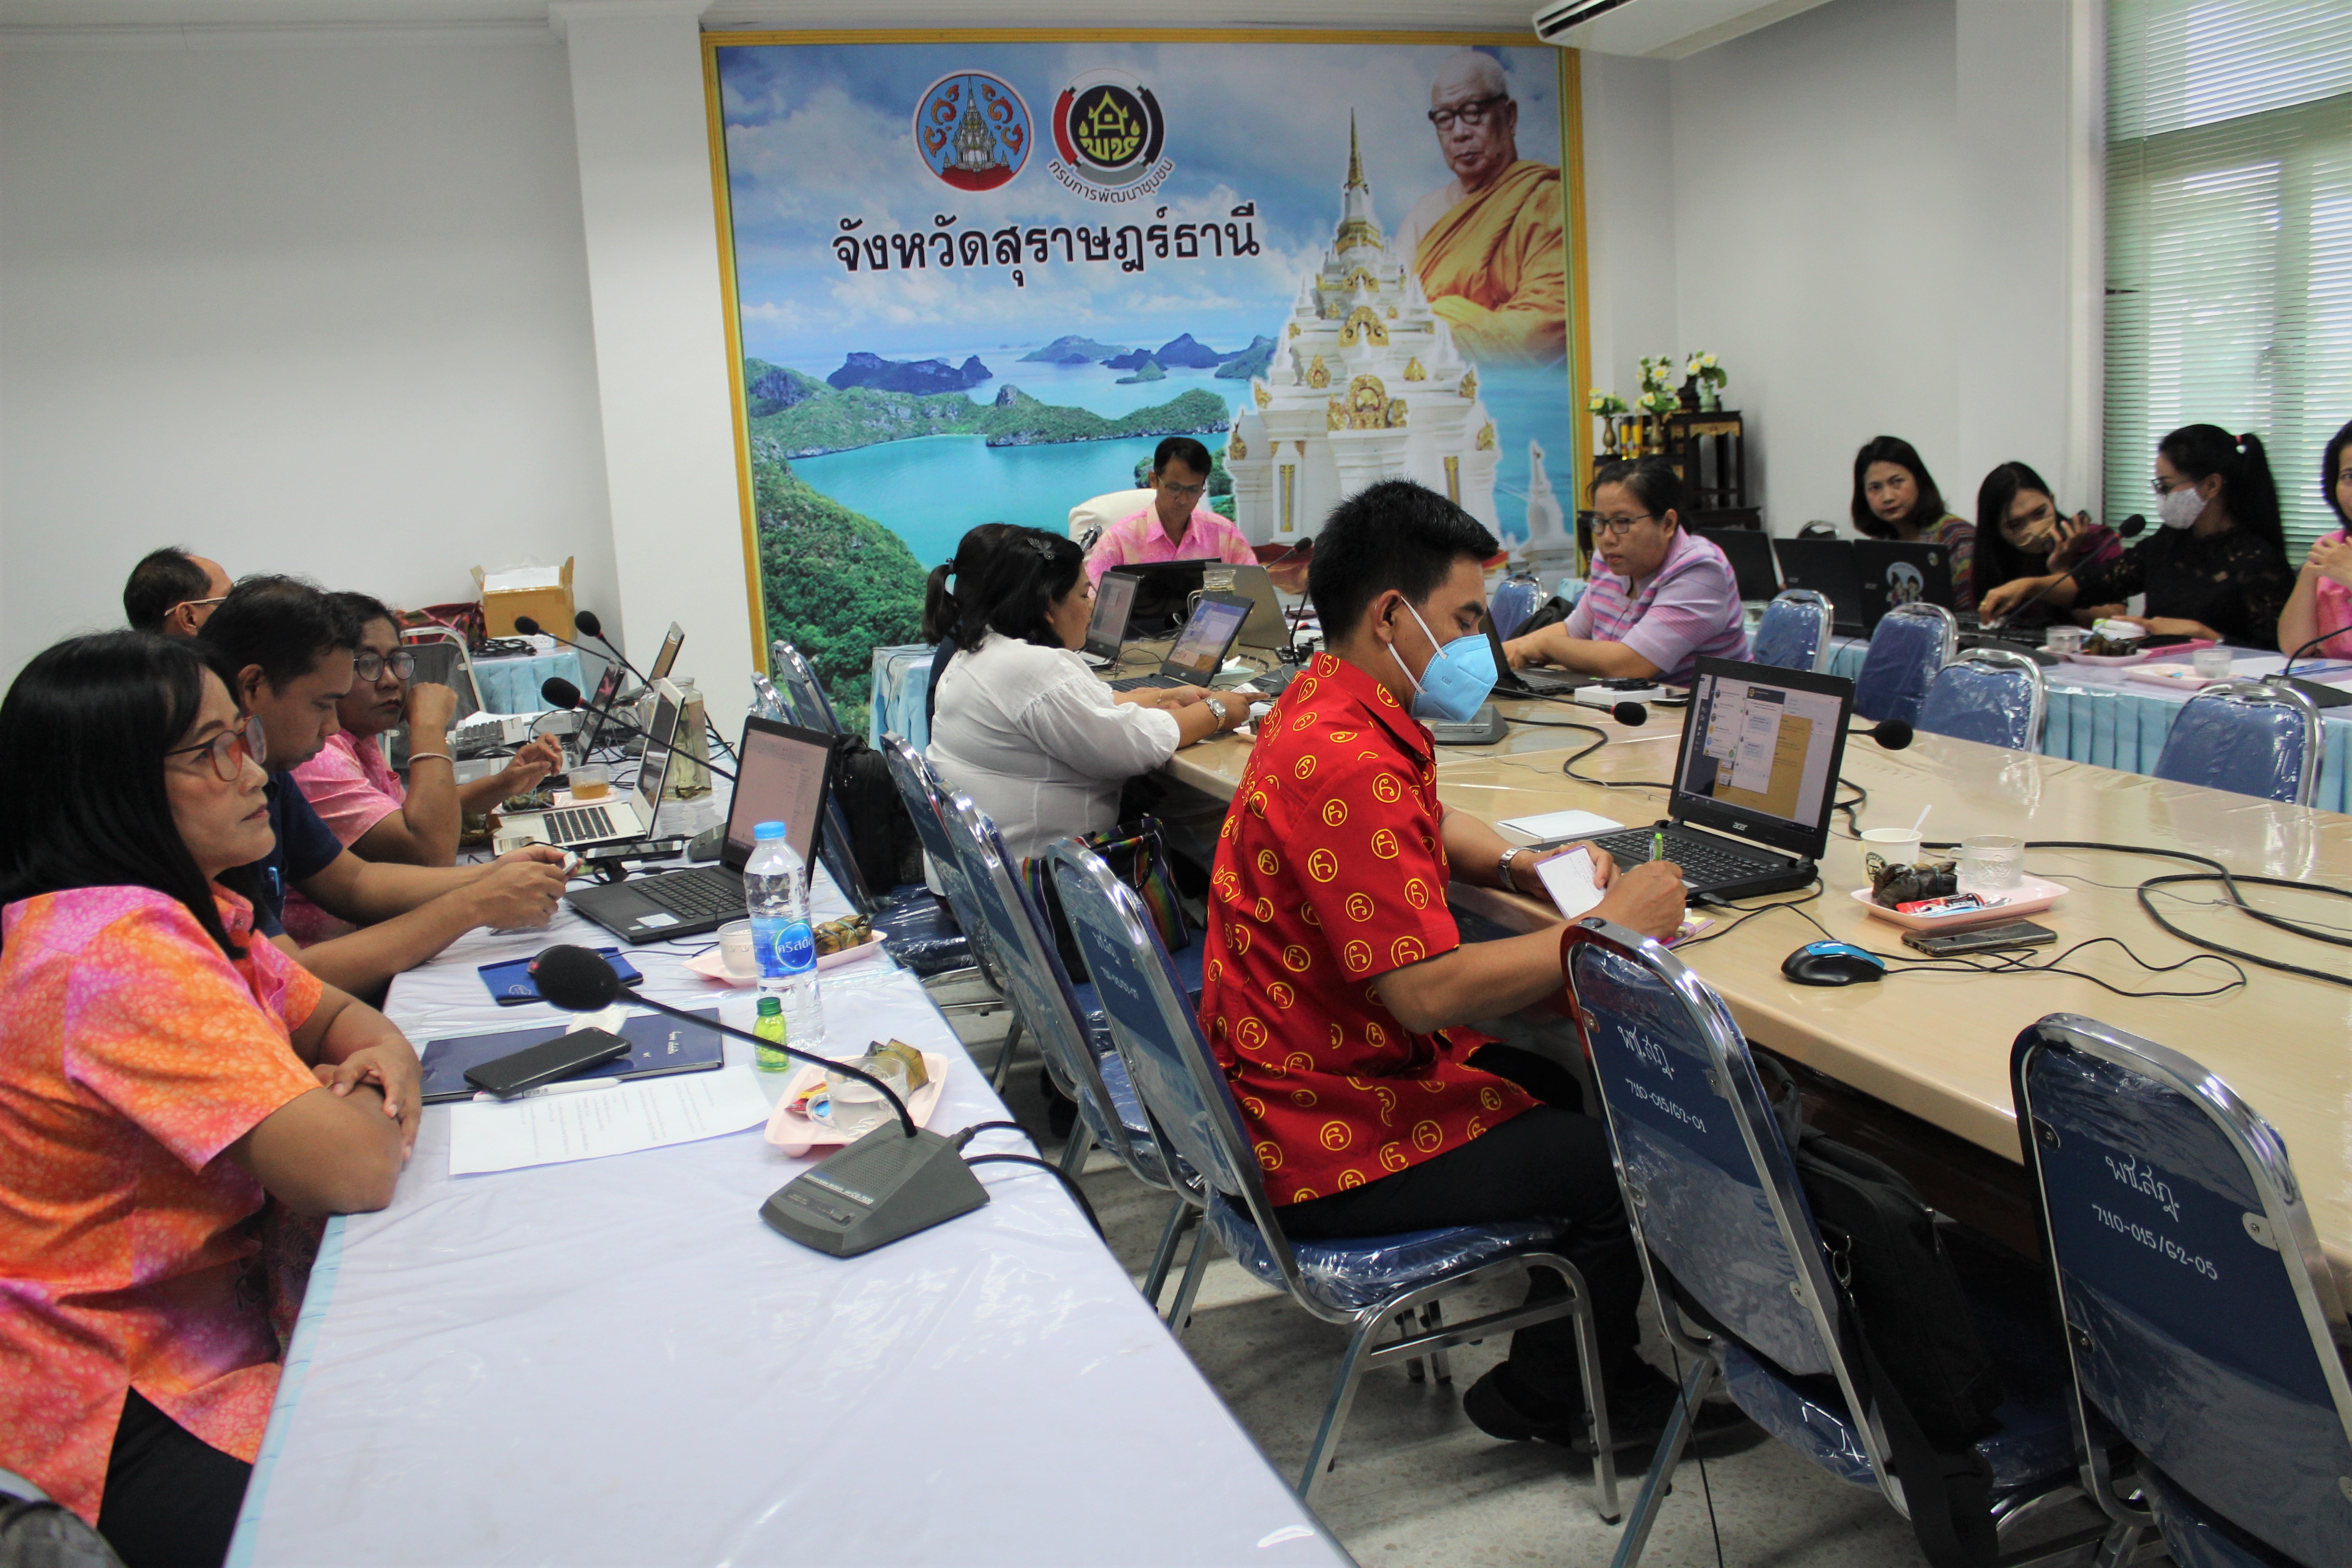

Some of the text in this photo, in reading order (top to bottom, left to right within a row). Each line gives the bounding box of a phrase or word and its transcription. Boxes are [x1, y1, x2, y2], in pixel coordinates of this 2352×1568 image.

[1049, 160, 1172, 202] กรมการพัฒนาชุมชน
[832, 202, 1259, 287] จังหวัดสุราษฎร์ธานี
[1733, 822, 1748, 831] acer
[1625, 1078, 1707, 1133] 7110-015/62-01
[2092, 1204, 2218, 1280] 7110-015/62-05
